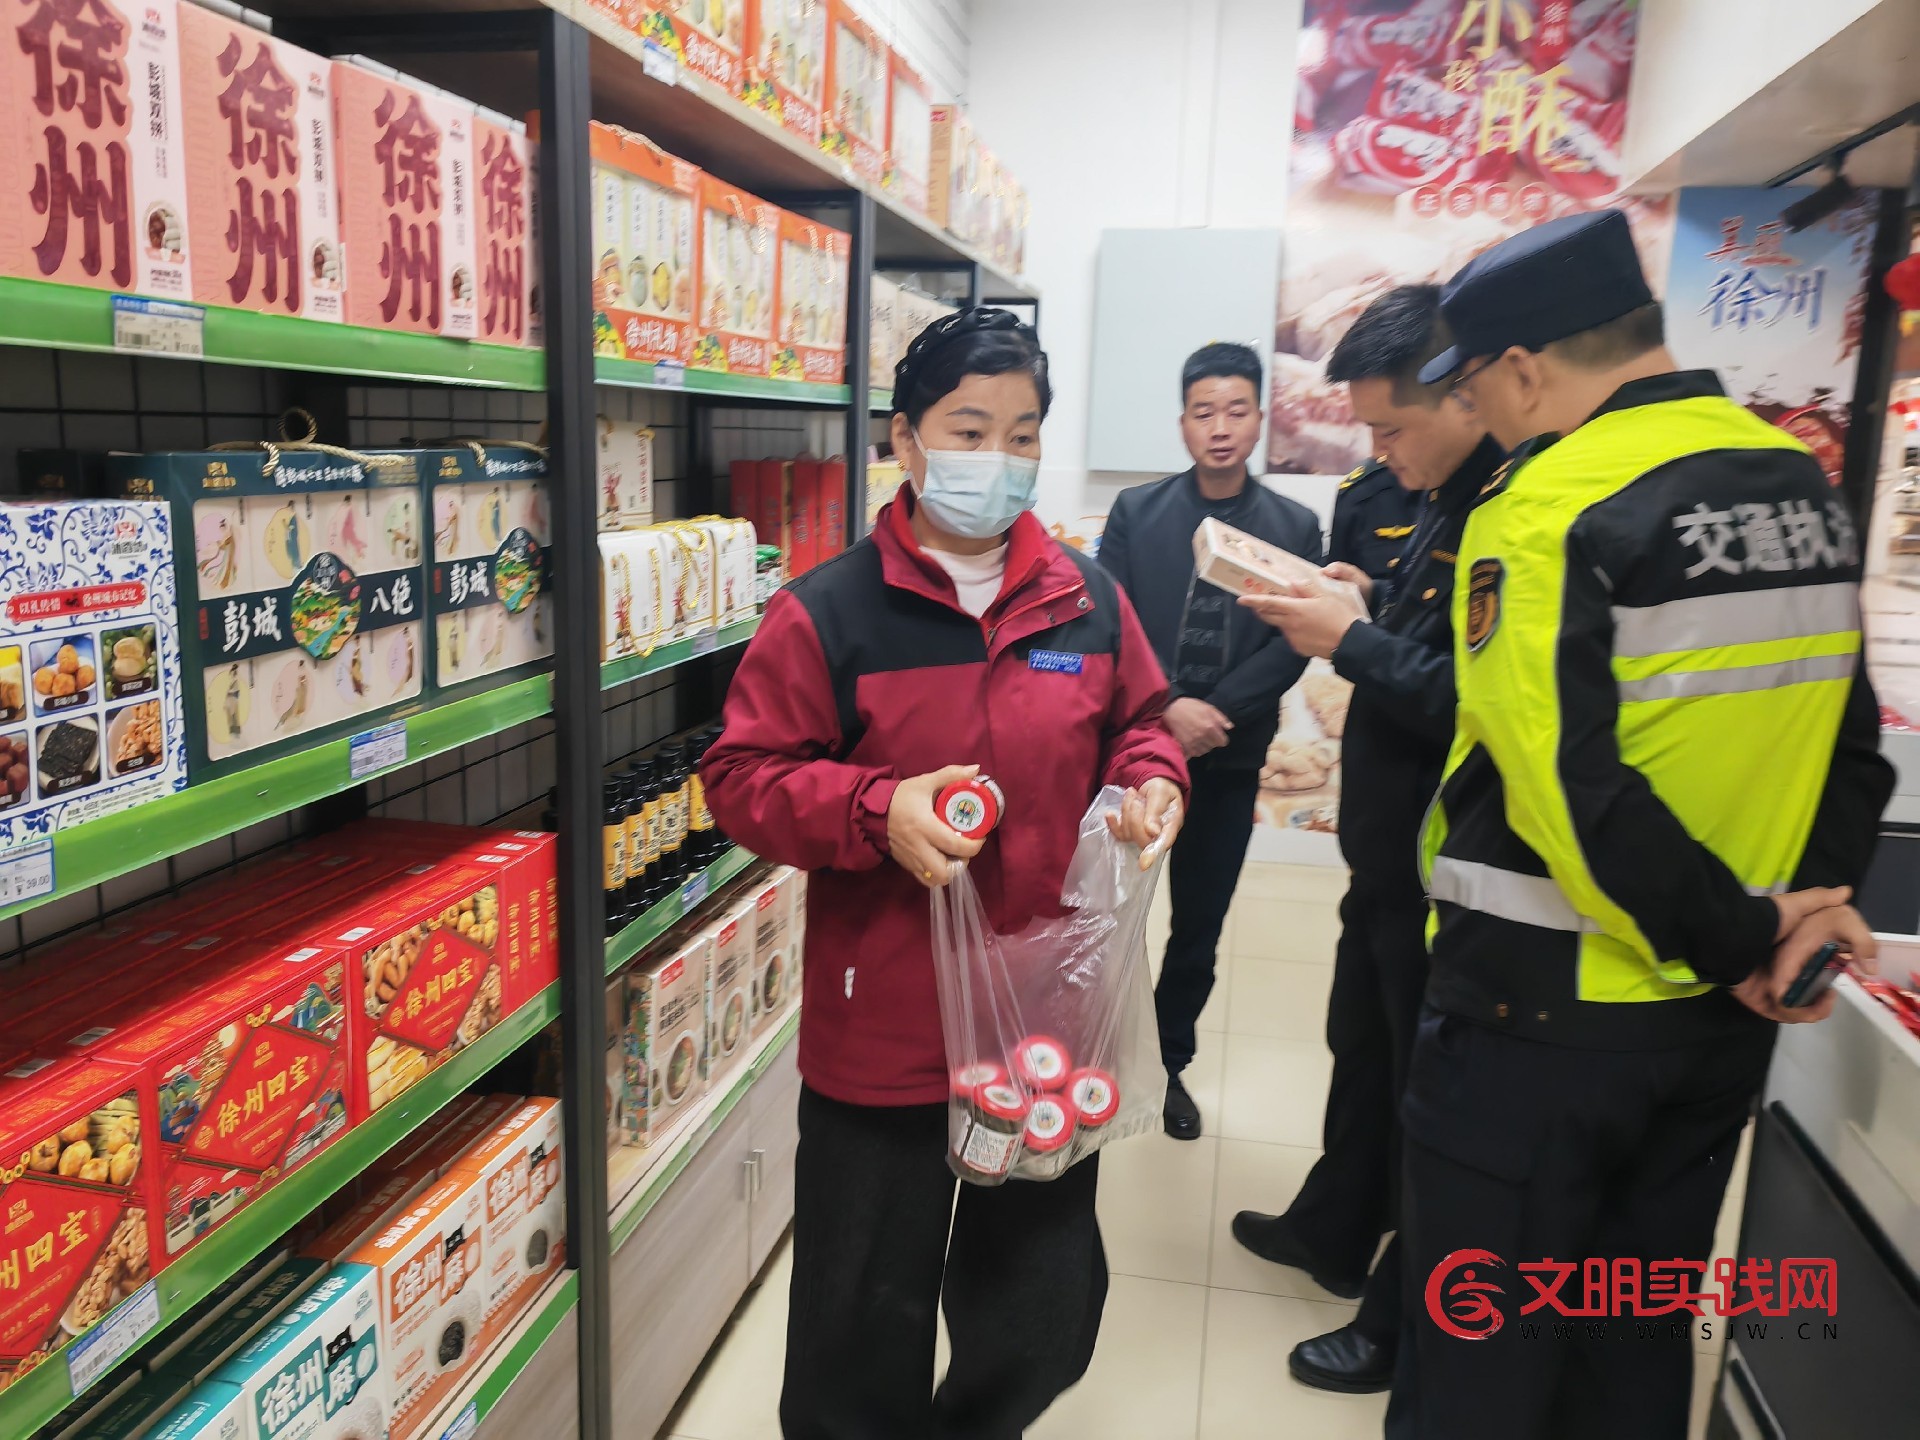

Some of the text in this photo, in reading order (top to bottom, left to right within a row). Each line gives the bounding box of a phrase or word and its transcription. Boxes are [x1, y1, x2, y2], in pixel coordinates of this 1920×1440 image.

[16, 0, 133, 290] 徐州
[216, 32, 301, 314] 徐州
[372, 88, 442, 331] 徐州
[480, 130, 525, 342] 徐州
[1697, 267, 1827, 333] 徐州
[222, 574, 414, 653] 彭城 八绝
[449, 561, 490, 605] 彭城
[405, 957, 474, 1019] 徐州四宝
[217, 1055, 310, 1138] 徐州四宝
[394, 1242, 465, 1314] 徐州麻
[261, 1349, 356, 1435] 徐州麻
